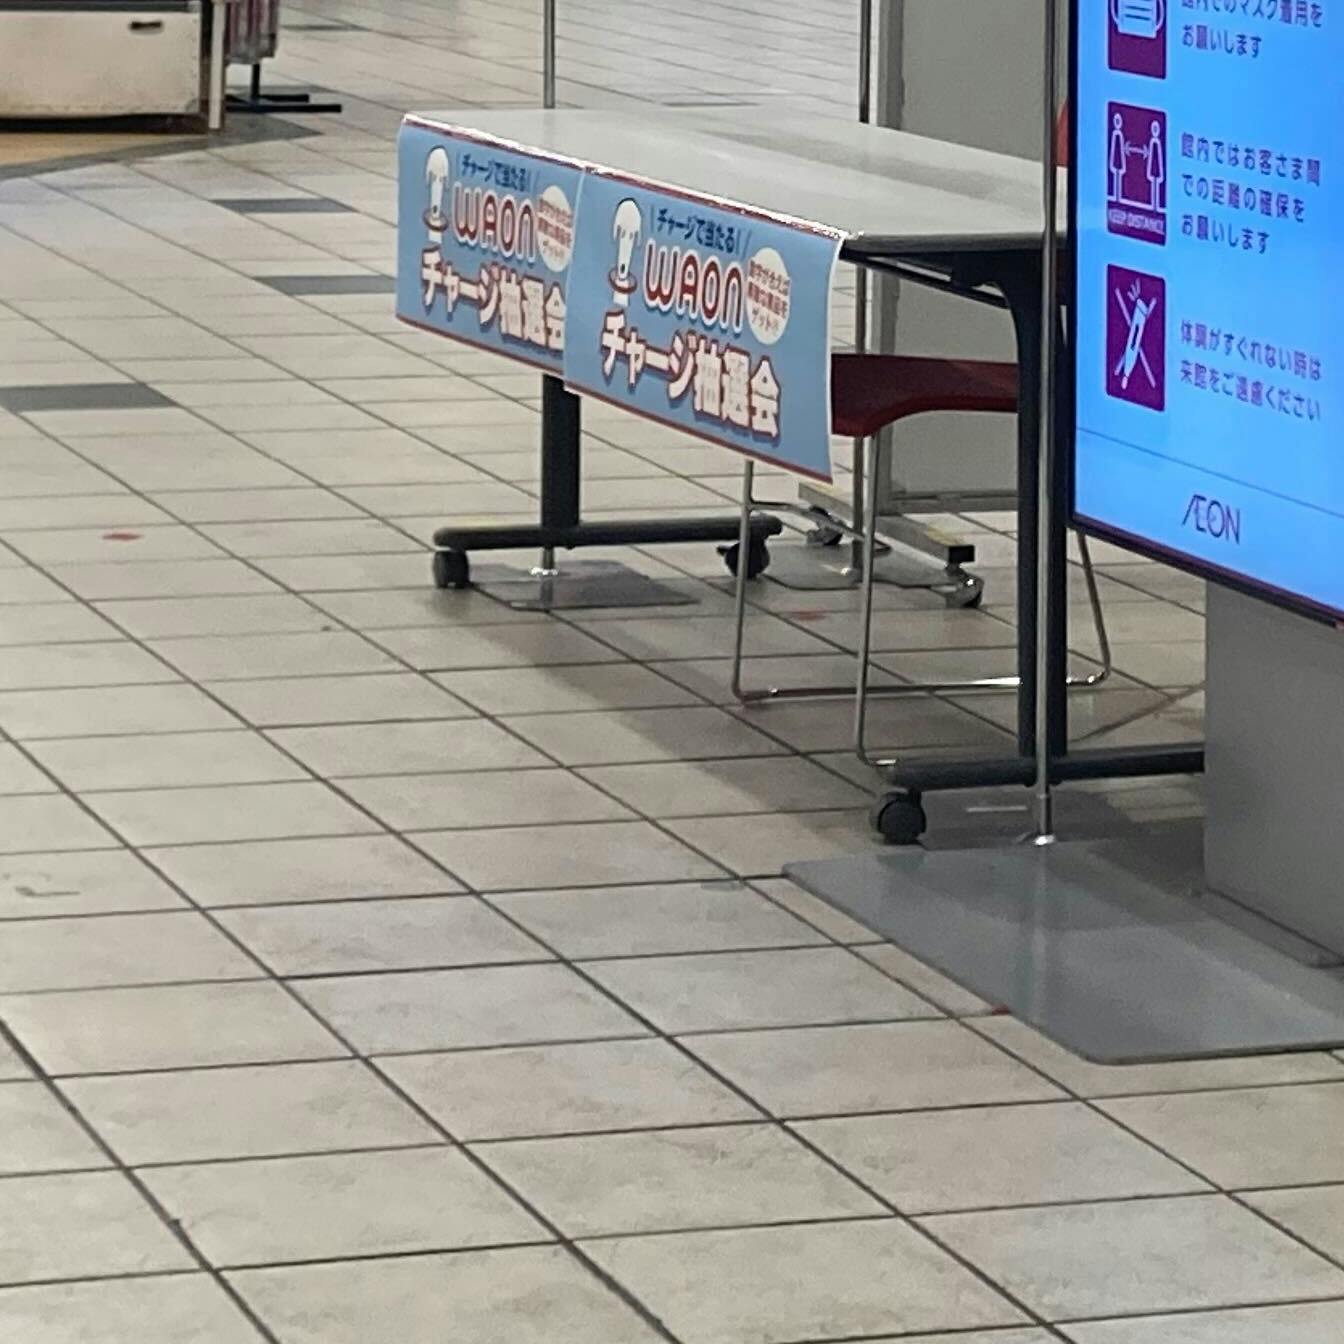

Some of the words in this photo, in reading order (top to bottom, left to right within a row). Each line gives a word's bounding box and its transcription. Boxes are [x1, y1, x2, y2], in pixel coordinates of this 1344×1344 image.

[1182, 25, 1263, 59] お願いします
[1180, 131, 1322, 187] 館内ではお客さま間
[1181, 172, 1306, 224] での距離の確保を
[1181, 212, 1270, 255] お願いします
[600, 307, 782, 440] チャージ抽選会
[1180, 318, 1322, 382] 体調がすぐれない時は
